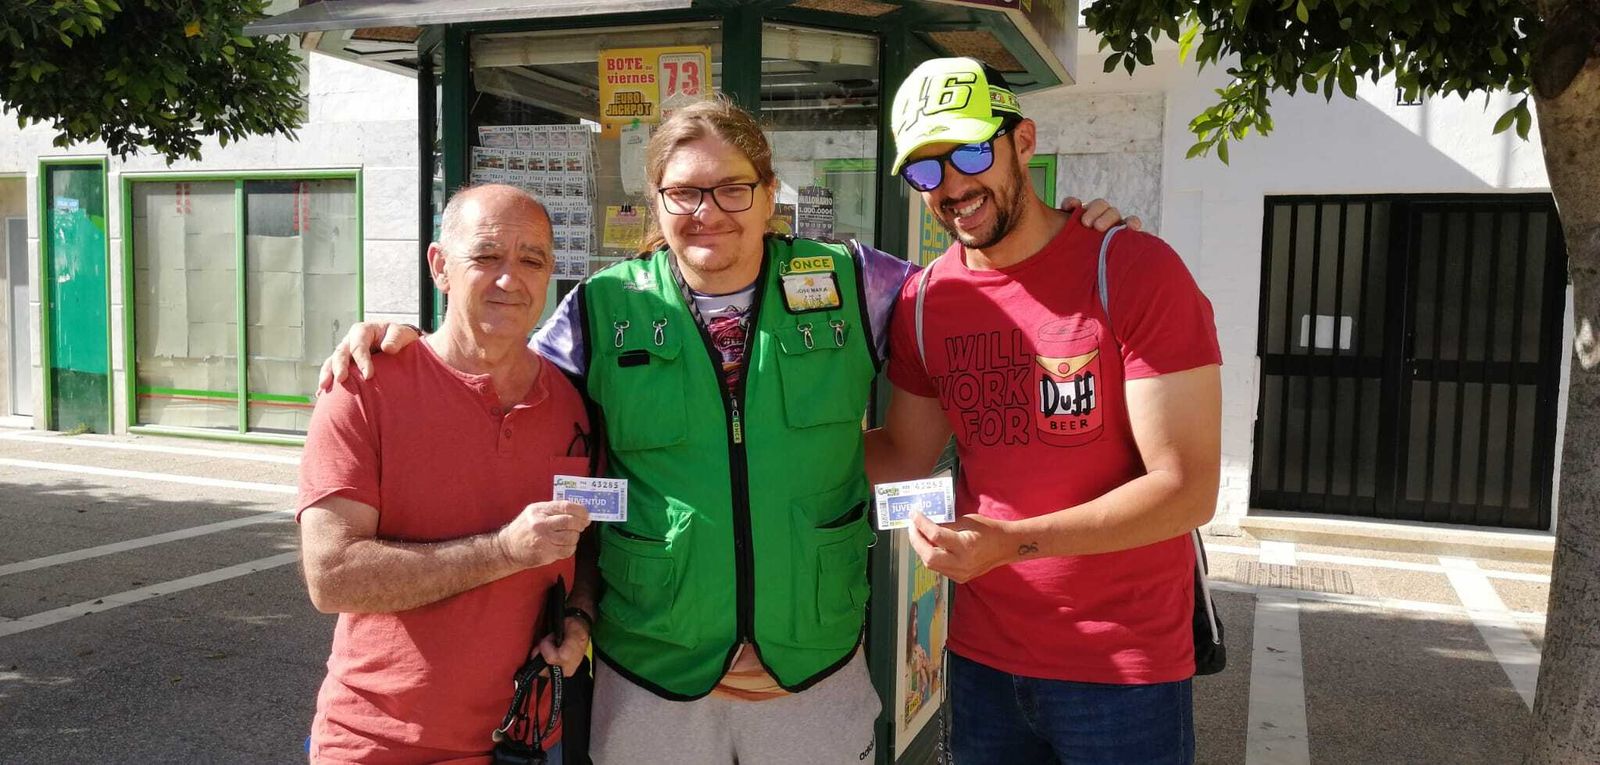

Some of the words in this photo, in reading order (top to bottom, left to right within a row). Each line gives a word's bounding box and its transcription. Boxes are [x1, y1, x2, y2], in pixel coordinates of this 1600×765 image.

[607, 57, 643, 71] BOTE
[607, 72, 655, 84] viernes
[662, 61, 700, 97] 73
[614, 91, 642, 104] EURO
[898, 72, 977, 135] 46
[606, 103, 652, 117] JACKPOT
[792, 258, 831, 270] ONCE
[945, 328, 1031, 373] WILL
[932, 367, 1030, 411] WORK
[1041, 371, 1095, 418] Duff
[961, 407, 1030, 447] FOR
[1050, 420, 1089, 431] BEER
[567, 495, 607, 506] JUVENTUD
